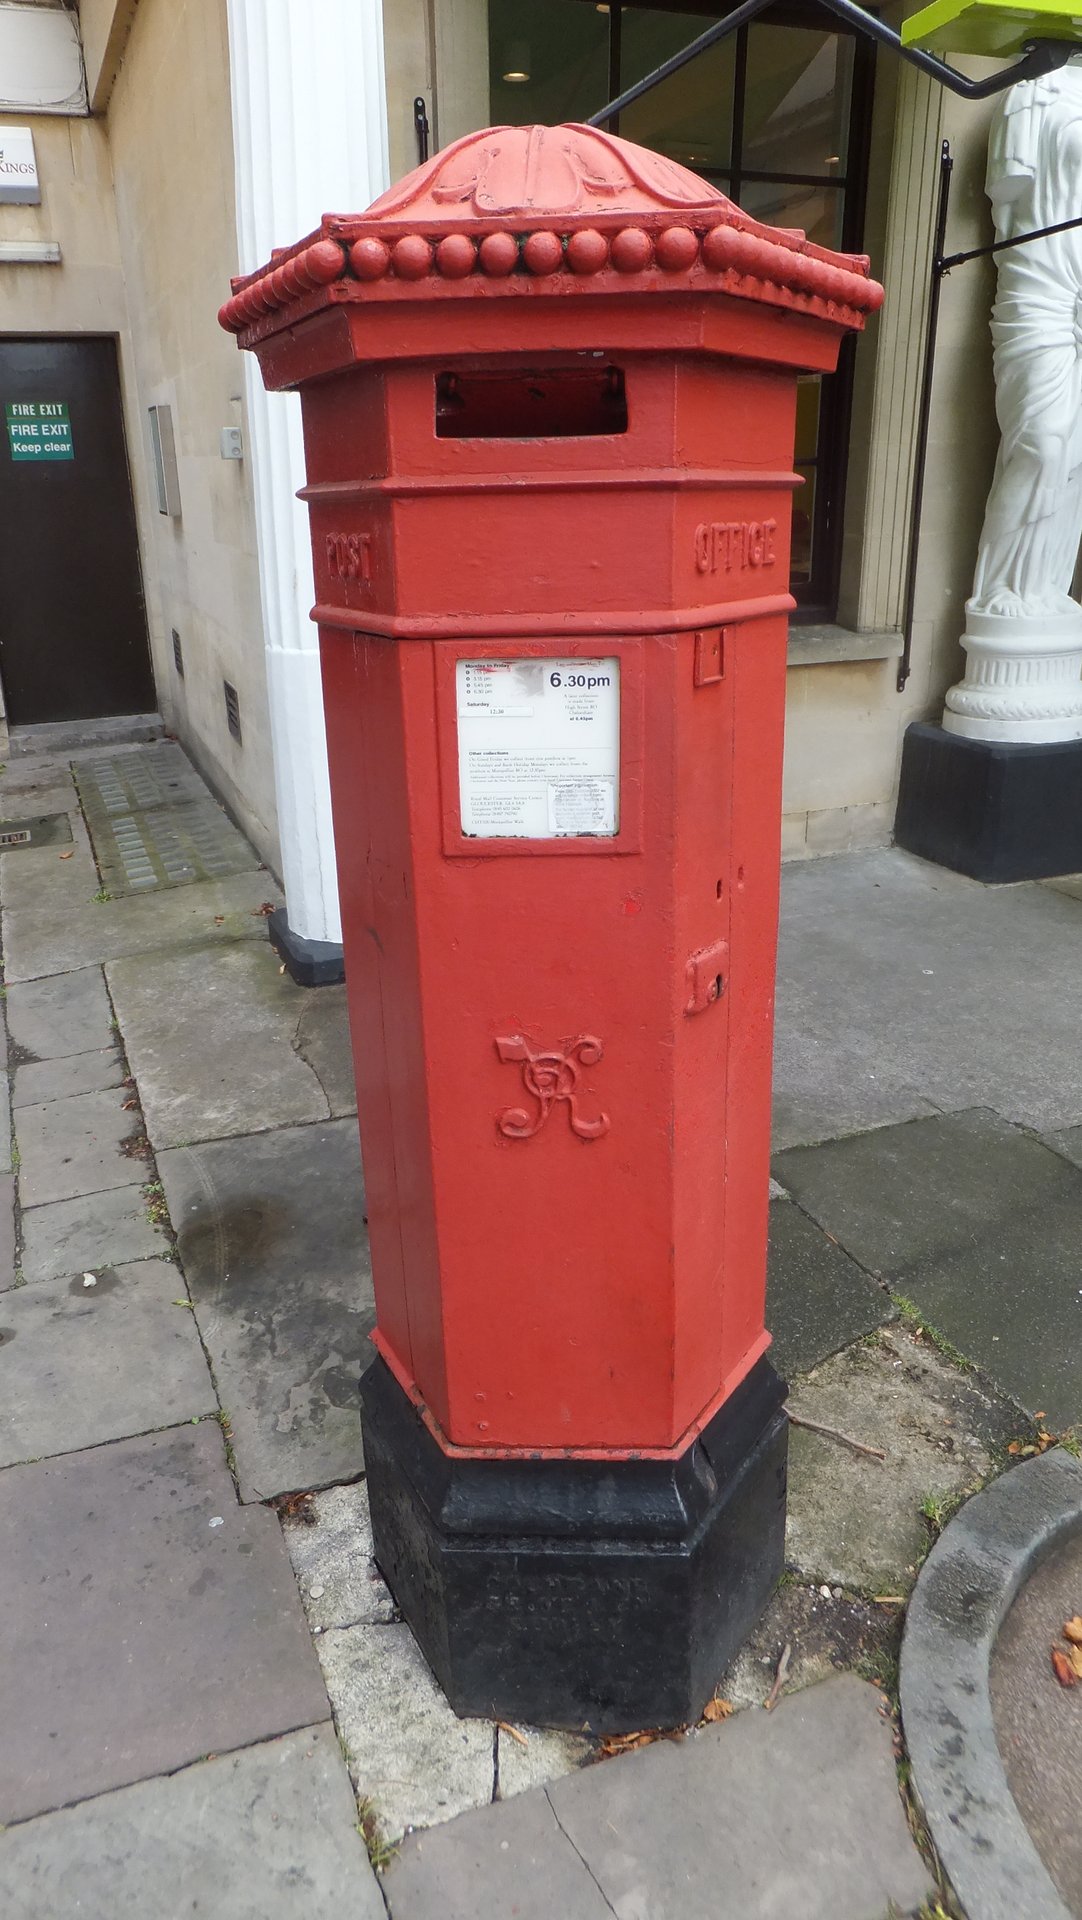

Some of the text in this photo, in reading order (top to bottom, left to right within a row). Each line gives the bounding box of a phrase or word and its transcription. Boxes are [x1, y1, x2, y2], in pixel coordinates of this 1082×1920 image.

[12, 404, 63, 416] FIRE EXIT
[11, 424, 68, 436] FIRE EXIT
[13, 442, 71, 454] Keep clear
[695, 518, 777, 575] OFFICE
[550, 672, 610, 690] 6.30pm
